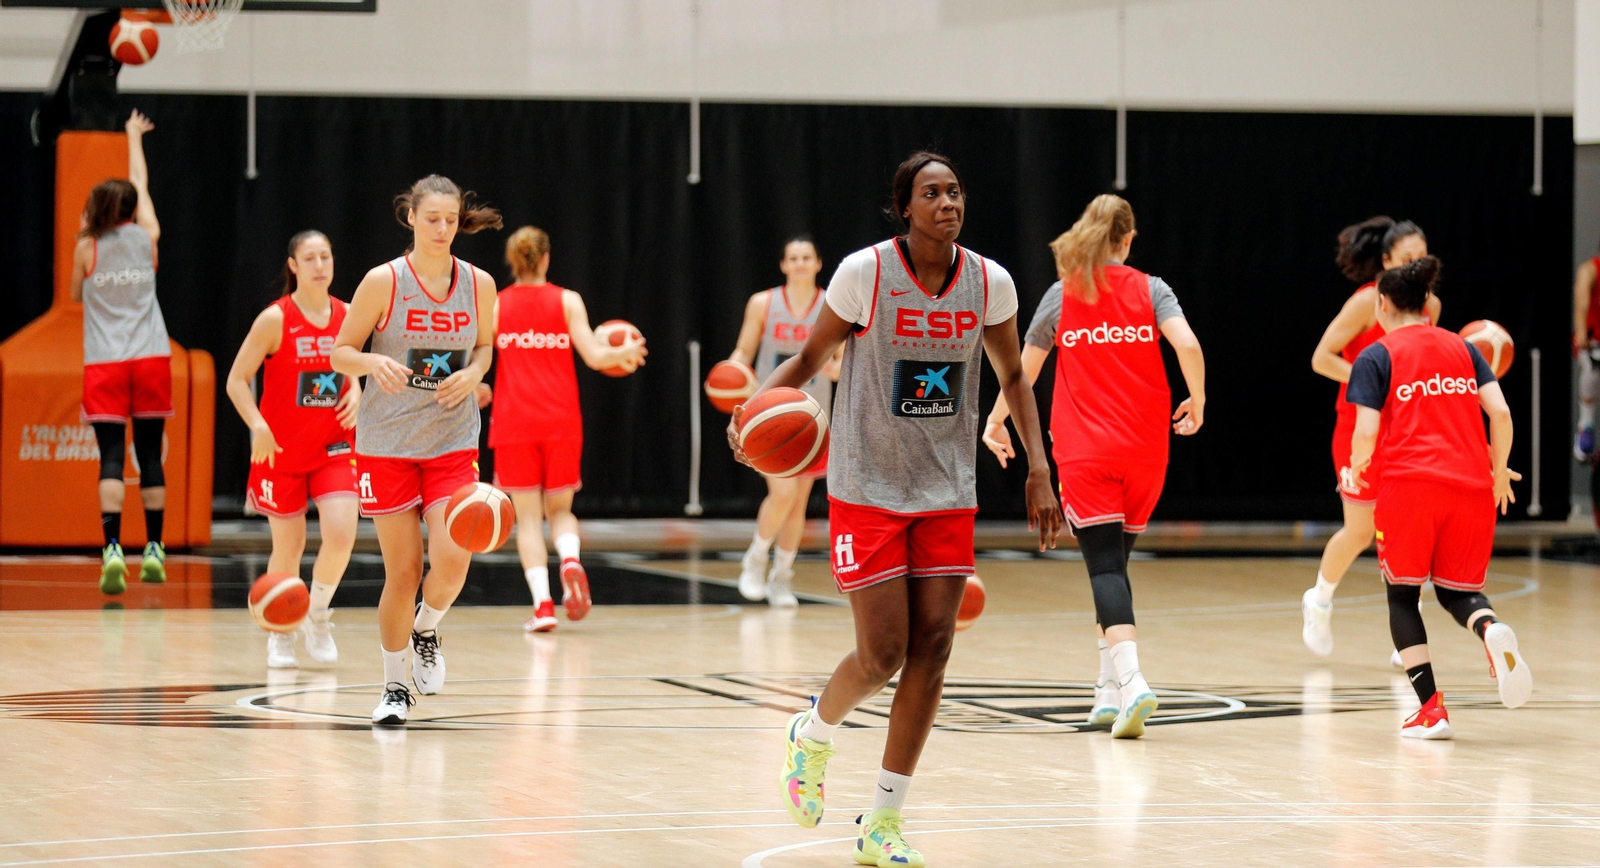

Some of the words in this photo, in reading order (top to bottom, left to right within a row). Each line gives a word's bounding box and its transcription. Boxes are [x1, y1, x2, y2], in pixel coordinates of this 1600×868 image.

[405, 308, 471, 333] ESP
[774, 322, 813, 342] ES
[895, 307, 978, 339] ESP
[497, 328, 570, 350] endesa
[1061, 321, 1154, 348] endesa
[296, 335, 338, 358] ES
[901, 401, 954, 415] CaixaBank
